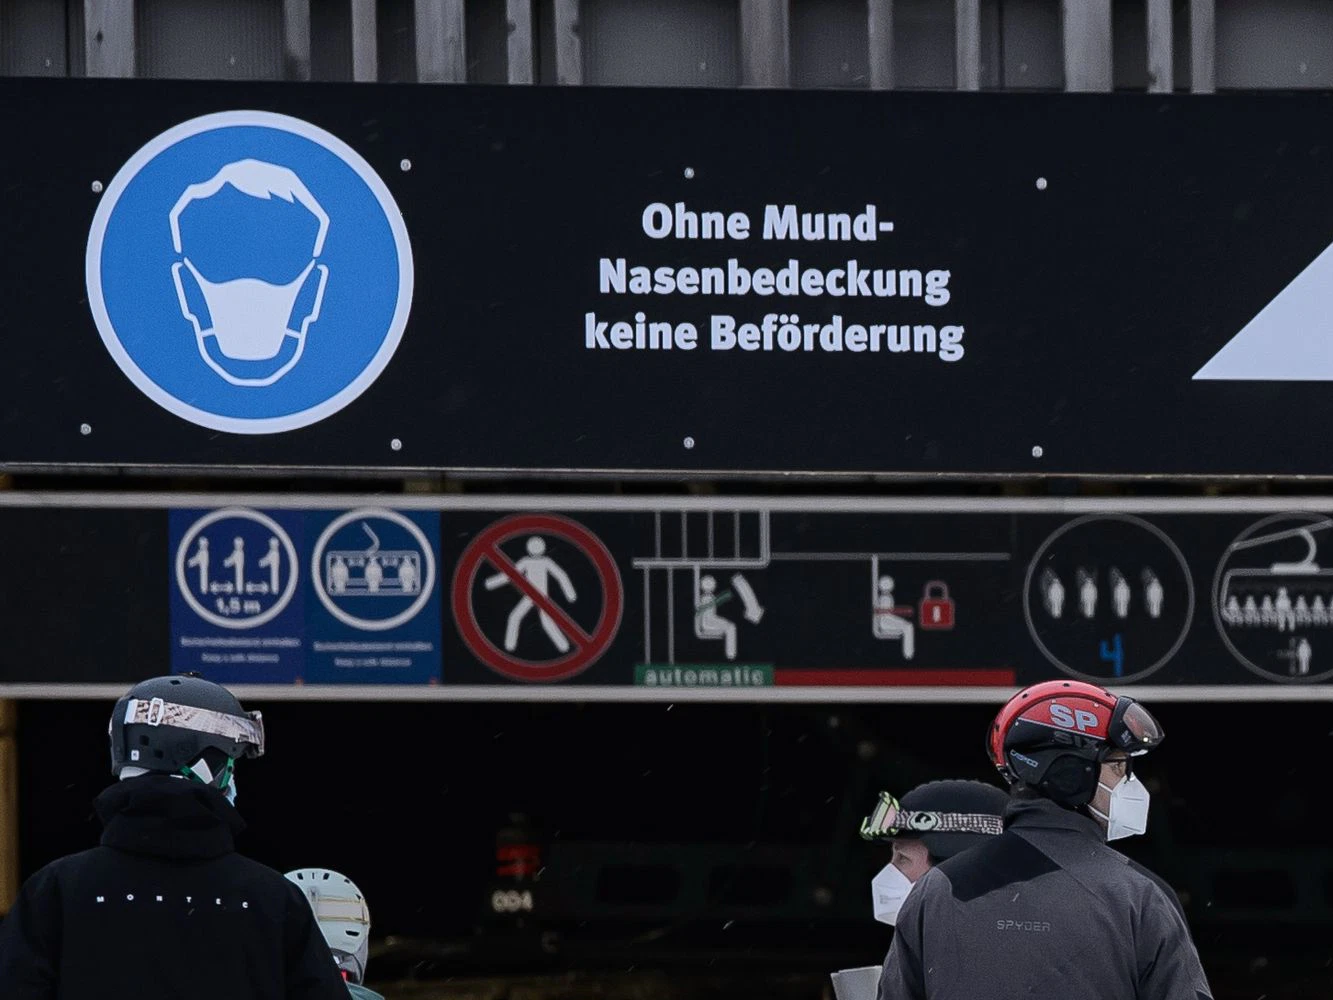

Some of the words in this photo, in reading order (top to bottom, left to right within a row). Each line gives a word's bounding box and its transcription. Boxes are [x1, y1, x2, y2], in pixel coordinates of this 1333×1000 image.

[641, 201, 751, 241] Ohne
[762, 202, 895, 243] Mund-
[598, 256, 952, 306] Nasenbedeckung
[584, 311, 699, 352] keine
[709, 312, 965, 362] Beförderung
[244, 599, 261, 613] m
[1098, 633, 1125, 677] 4
[643, 667, 764, 686] automatic
[1049, 702, 1100, 733] SP
[996, 919, 1051, 932] SPYDER
